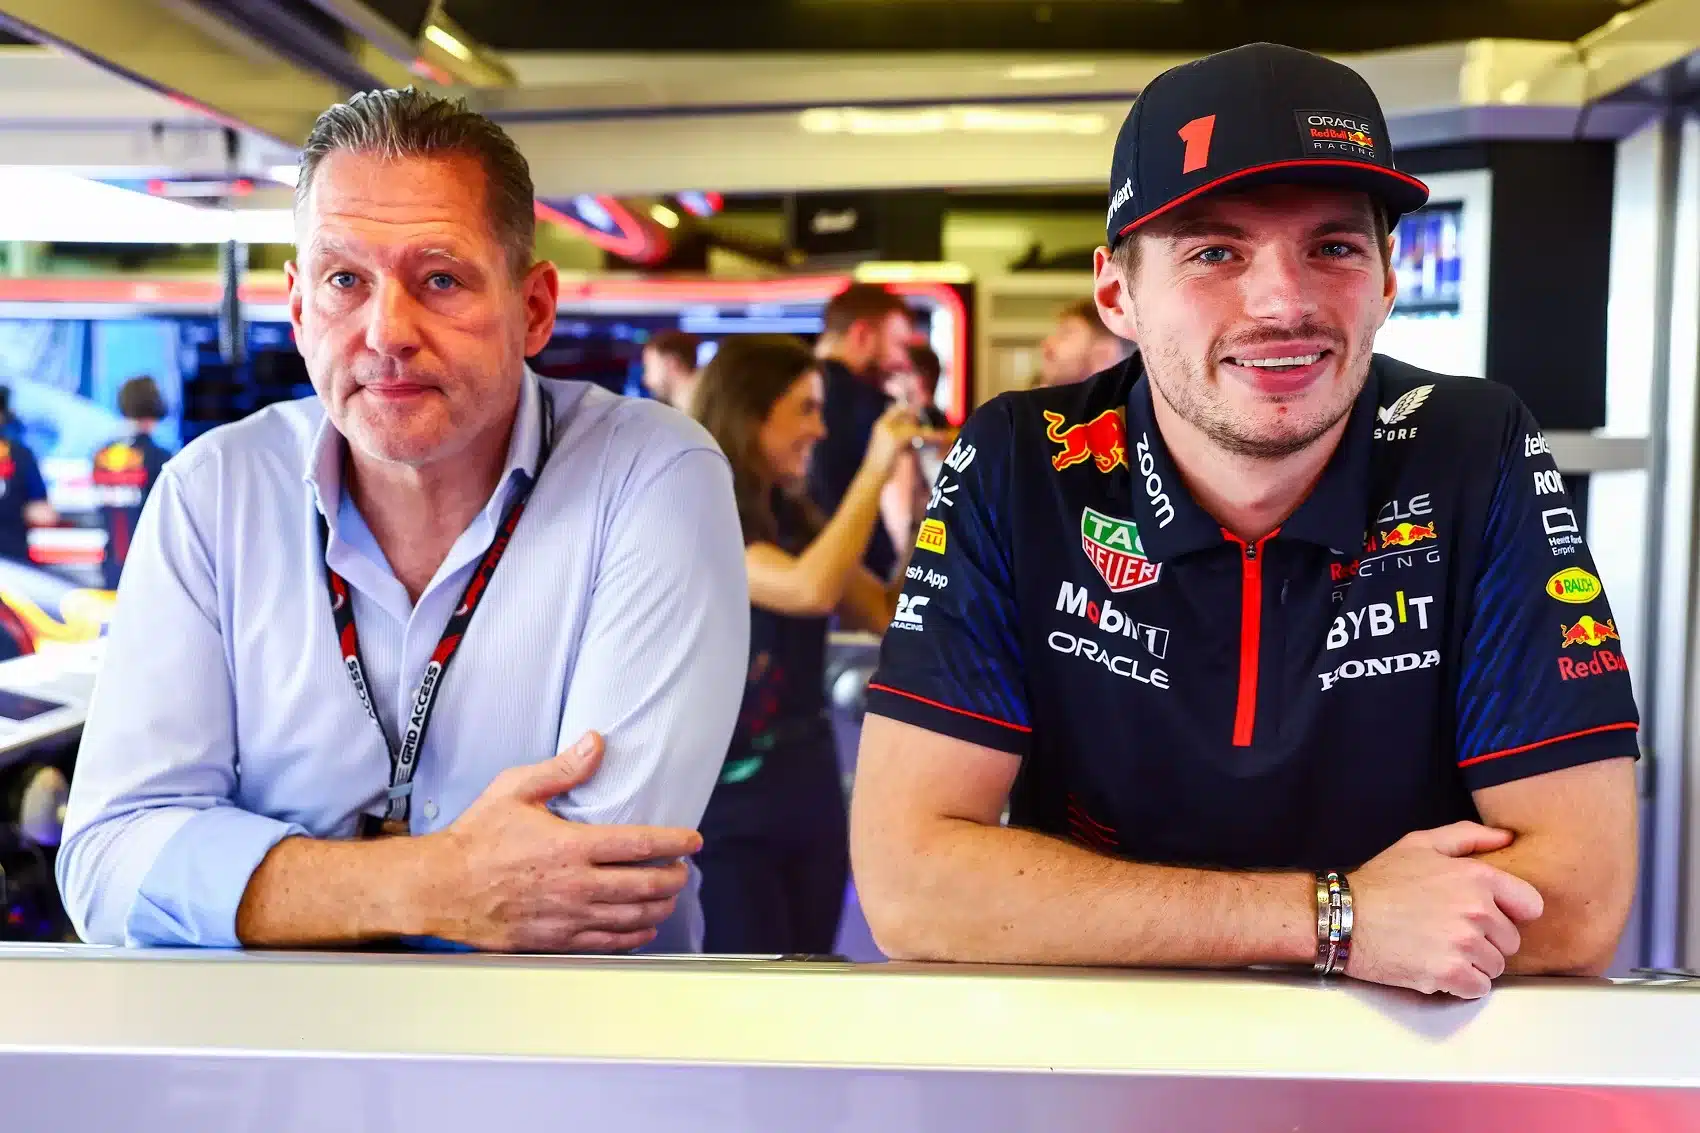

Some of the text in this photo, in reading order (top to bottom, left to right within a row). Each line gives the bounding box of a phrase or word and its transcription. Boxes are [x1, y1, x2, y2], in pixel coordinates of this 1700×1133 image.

[1178, 114, 1217, 175] 1
[1307, 115, 1371, 135] ORACLE
[1313, 142, 1376, 159] RACING
[1136, 432, 1175, 529] zoom
[923, 568, 949, 589] App
[1084, 540, 1156, 588] HEUER
[1331, 550, 1441, 603] RCING
[1563, 578, 1595, 594] RAUCH
[1326, 590, 1434, 650] BYBIT
[1048, 630, 1171, 690] ORACLE
[1318, 649, 1441, 691] HONDA
[401, 664, 439, 765] GRID ACCESS
